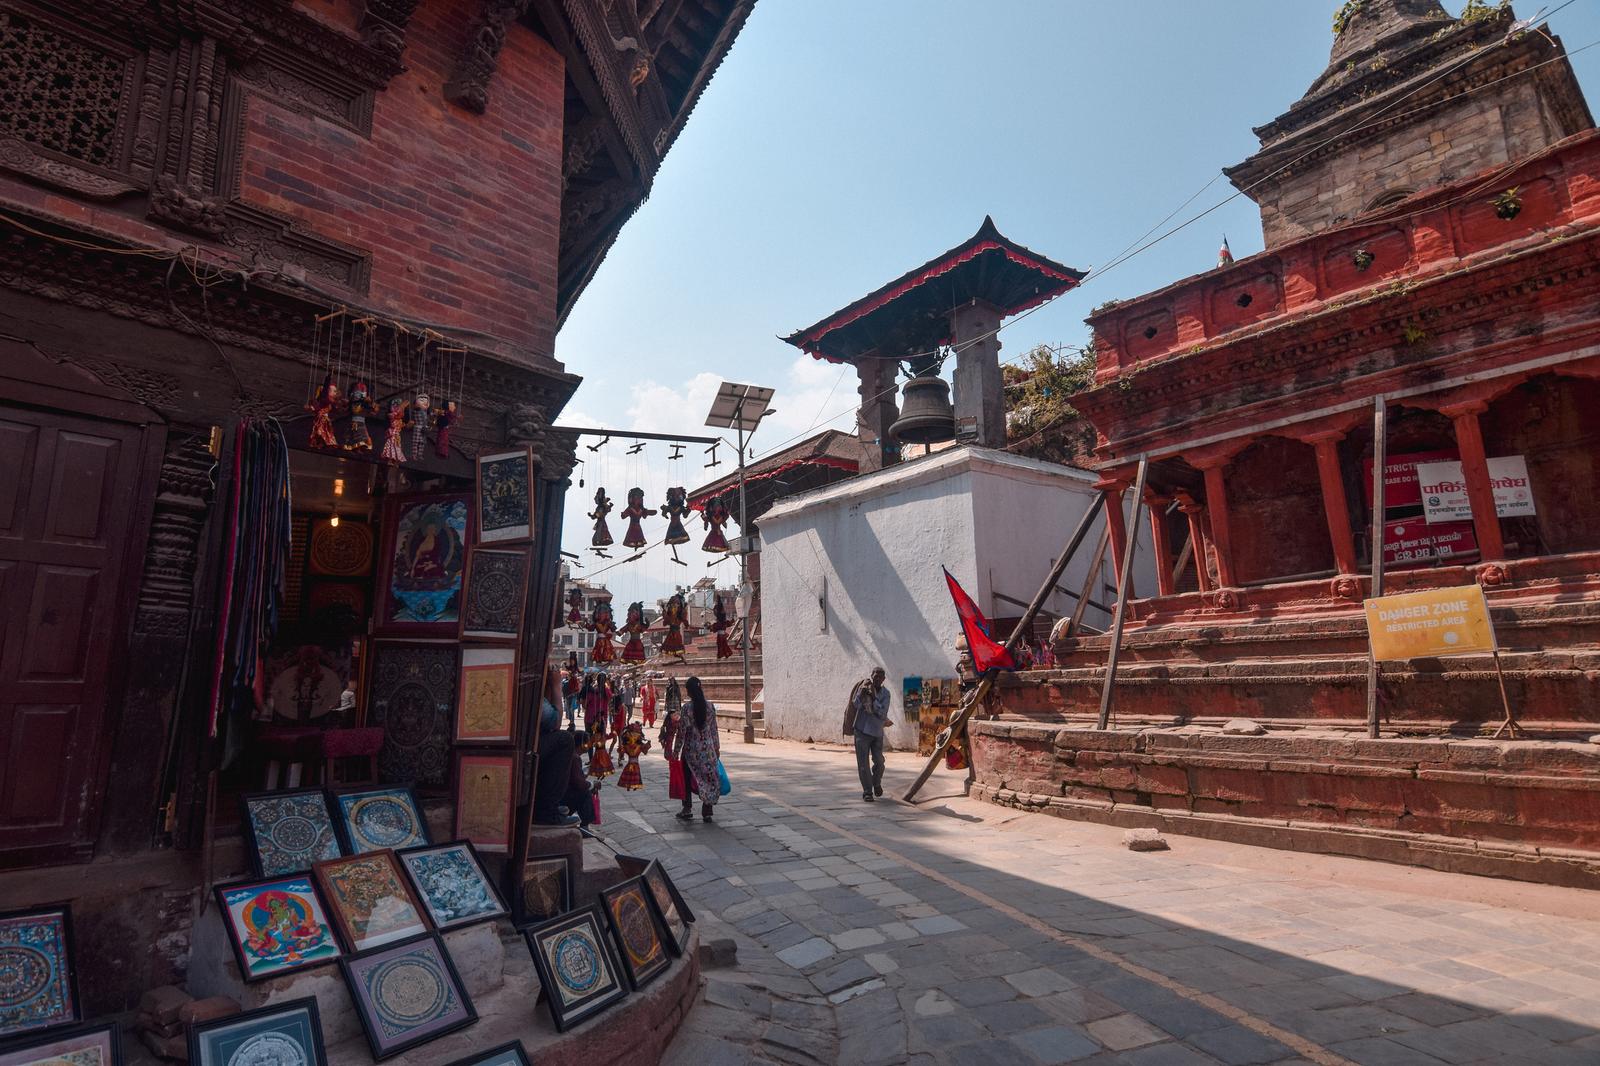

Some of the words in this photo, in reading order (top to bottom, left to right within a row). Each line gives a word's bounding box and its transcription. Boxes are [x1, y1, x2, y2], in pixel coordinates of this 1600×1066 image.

[1379, 605, 1429, 621] DANGER
[1432, 600, 1470, 615] ZONE
[1386, 620, 1440, 632] RESTRICTED
[1441, 616, 1466, 627] AREA
